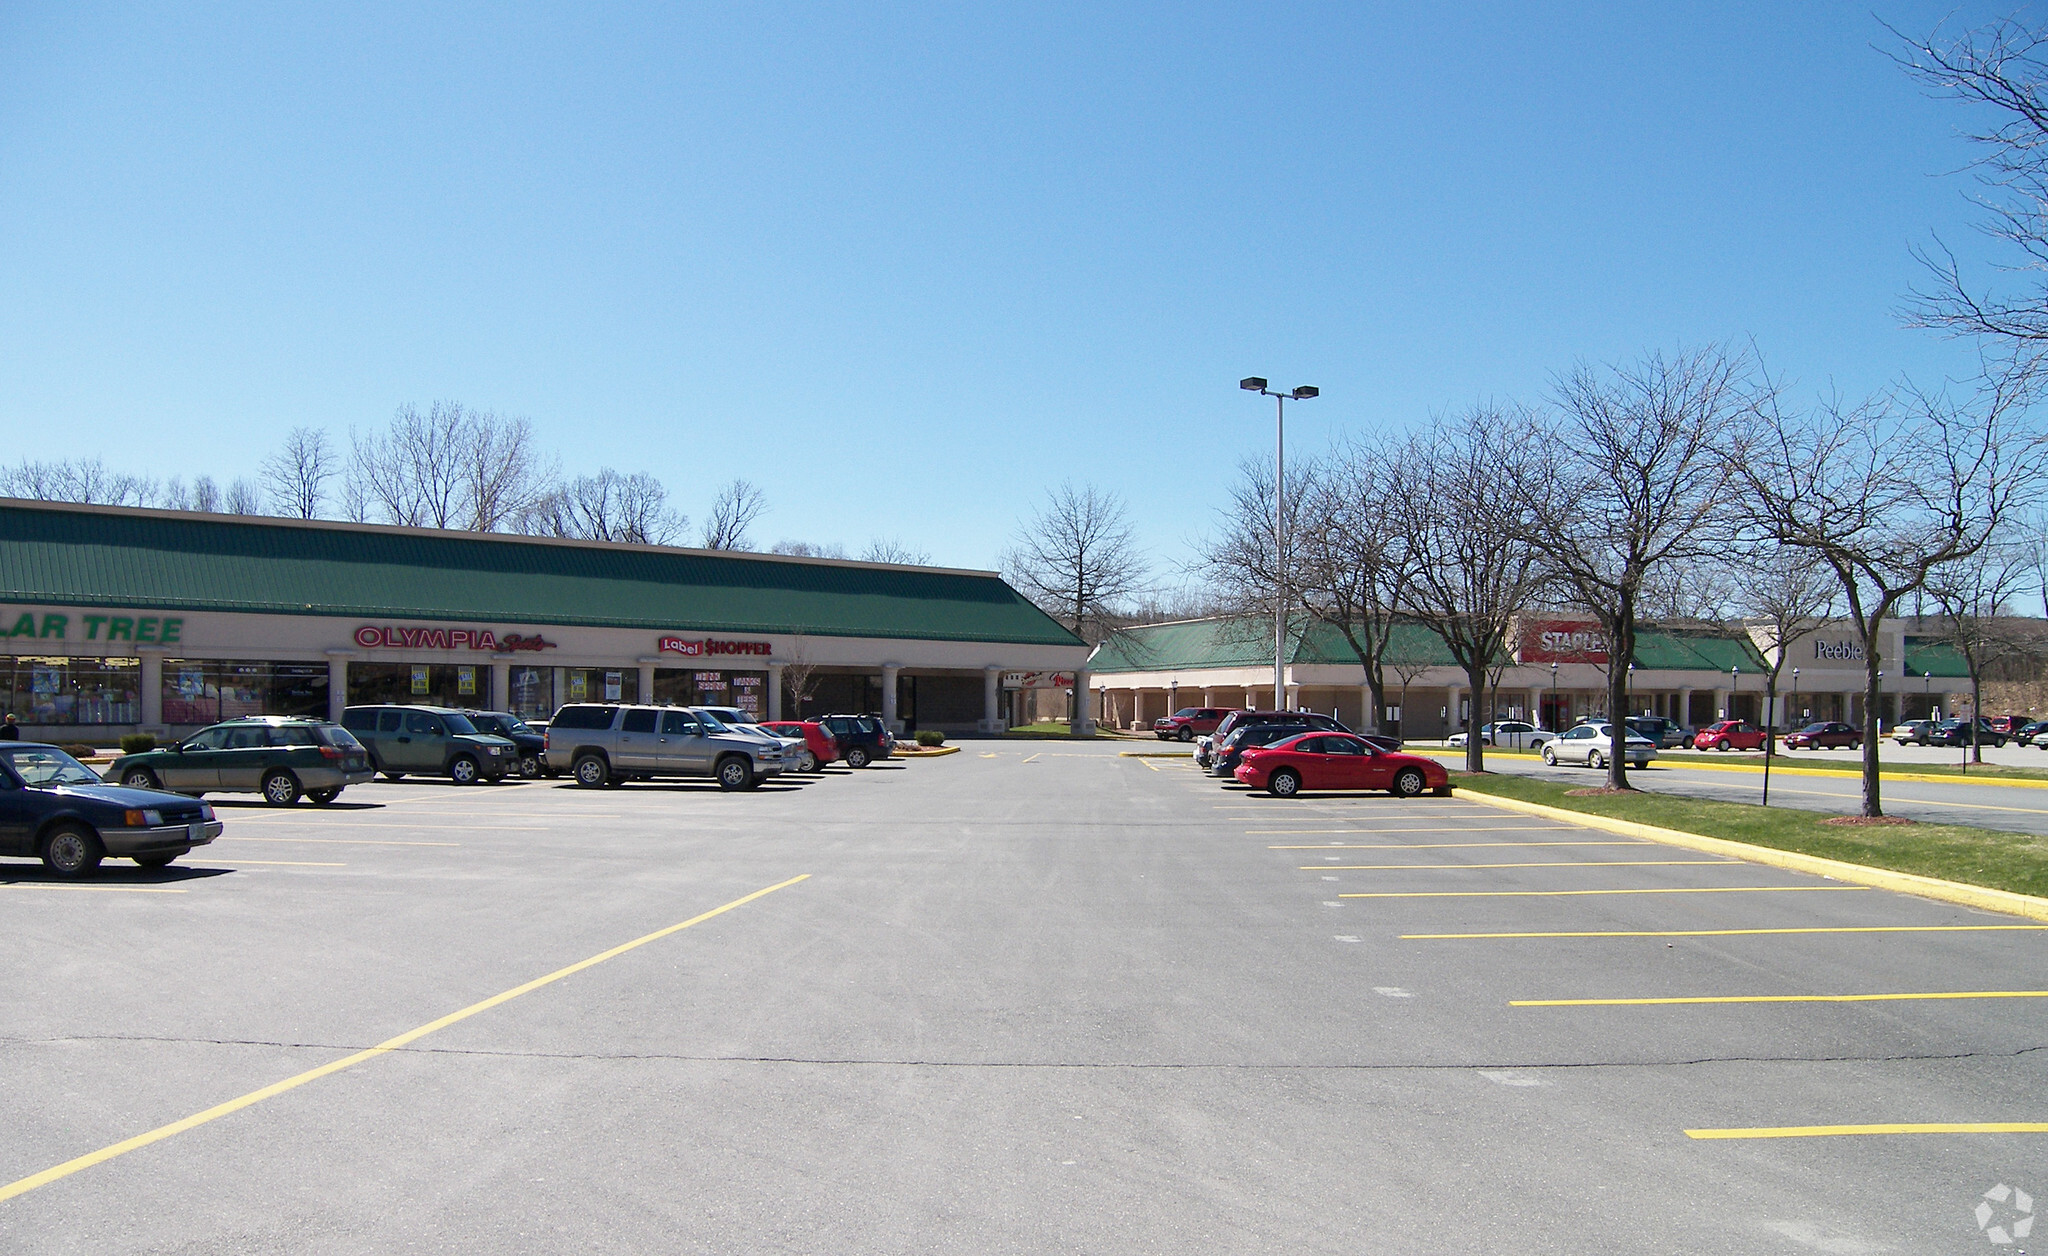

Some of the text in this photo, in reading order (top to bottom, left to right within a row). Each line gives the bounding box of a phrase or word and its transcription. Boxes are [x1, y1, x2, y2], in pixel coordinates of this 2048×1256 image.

[83, 615, 183, 642] TREE
[354, 626, 498, 650] OLYMPIA
[664, 639, 699, 655] Label
[1540, 631, 1607, 653] STAPLE
[1815, 640, 1866, 660] Peeble
